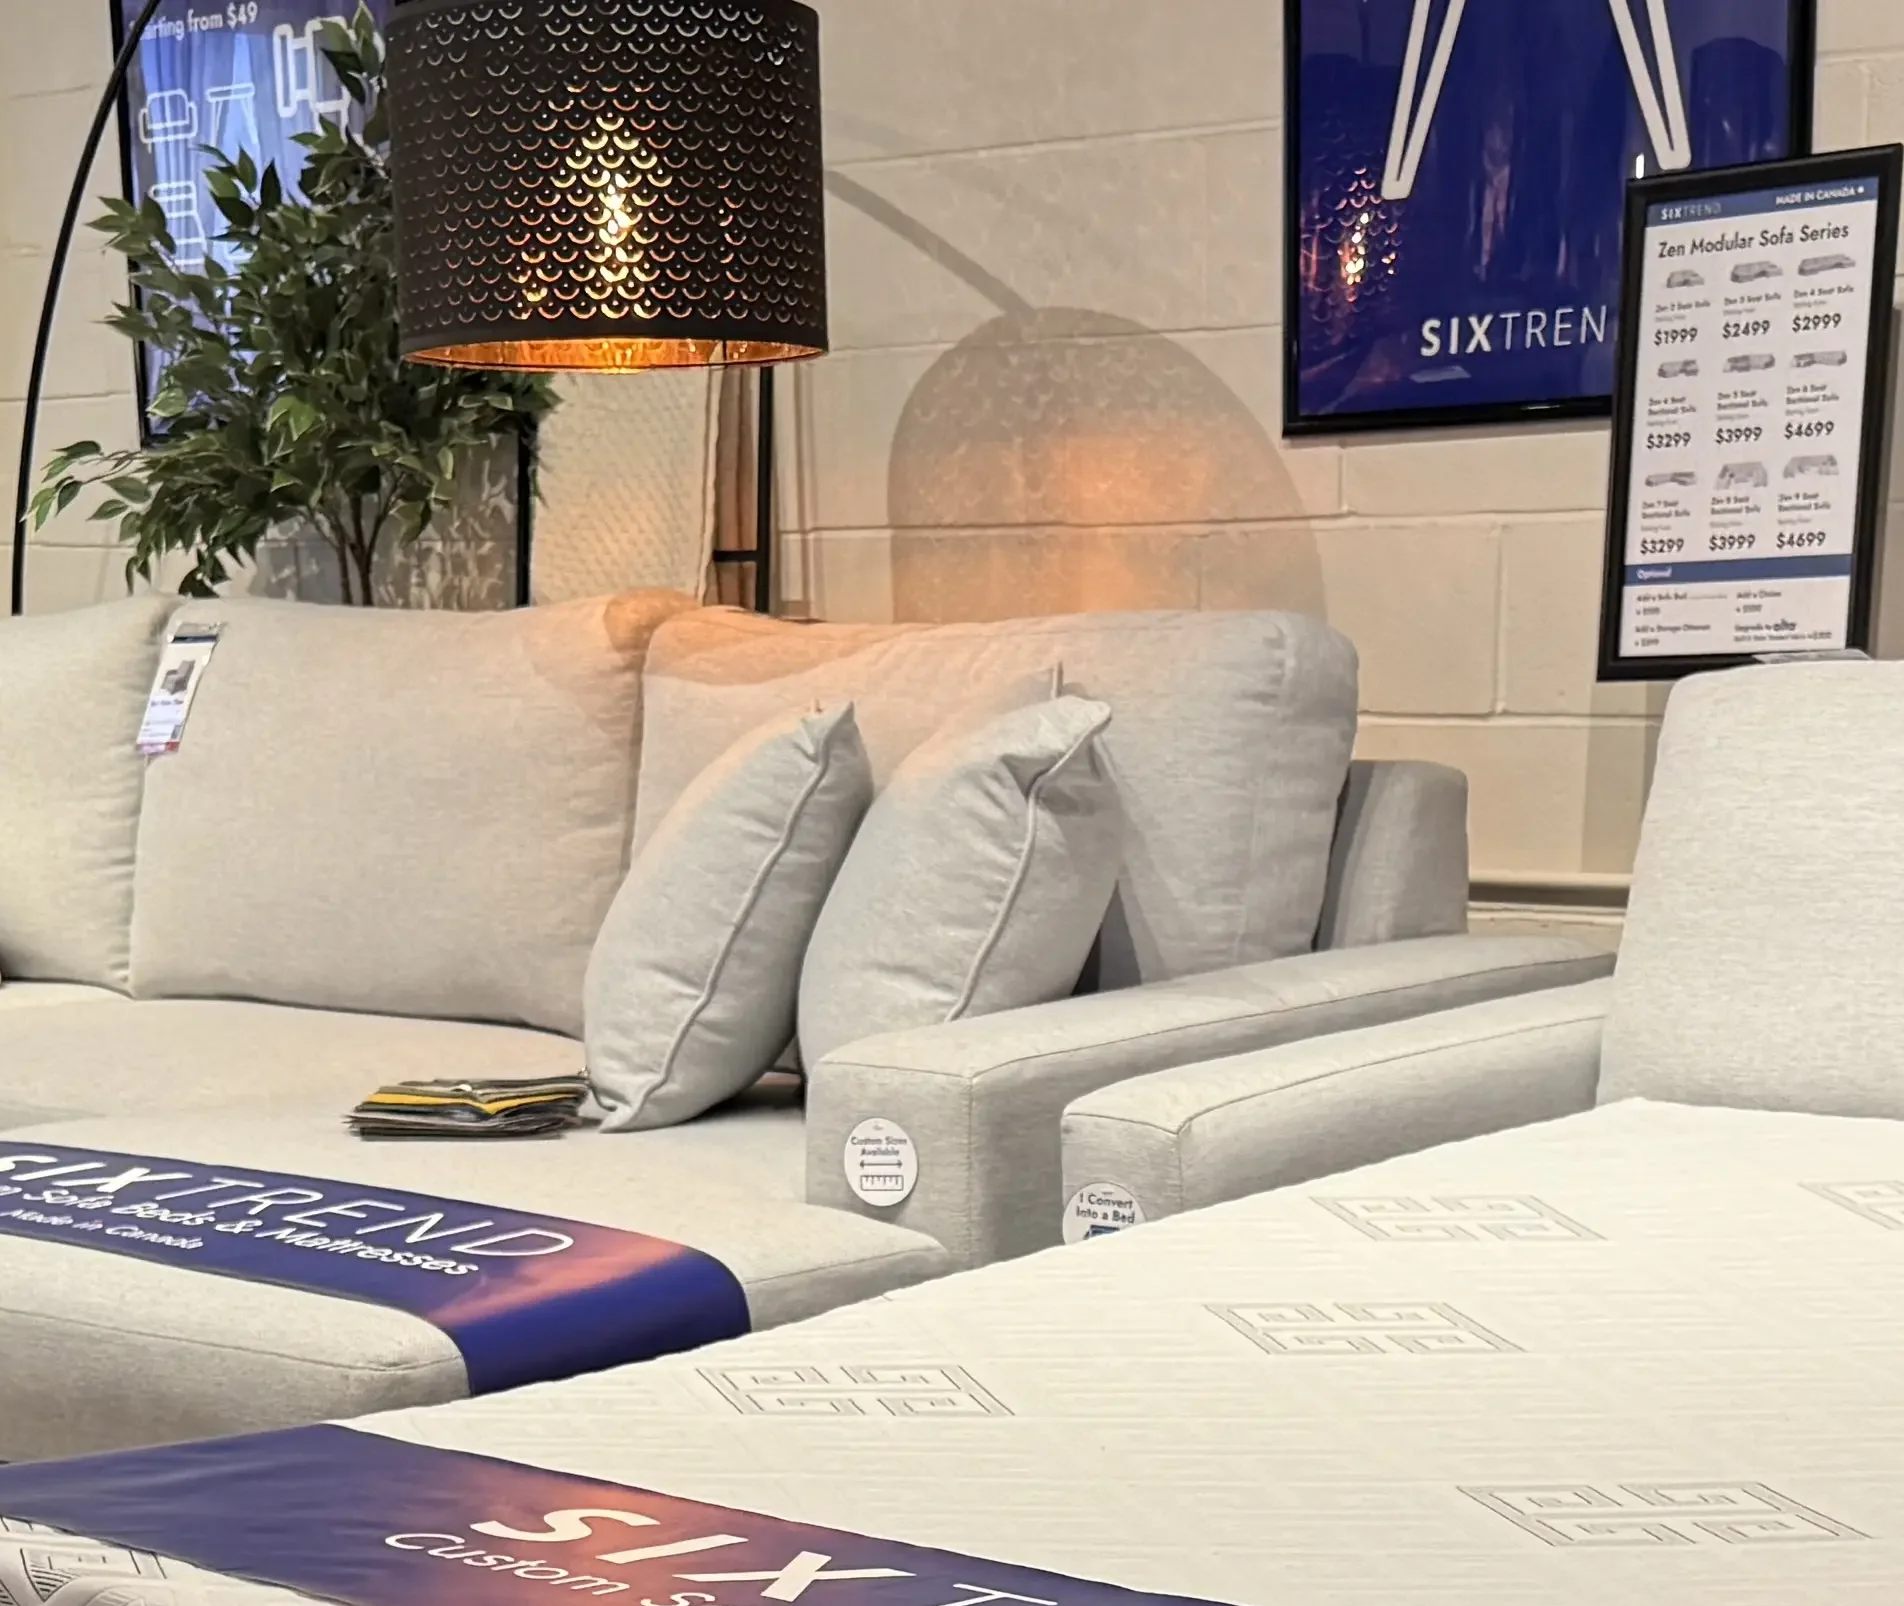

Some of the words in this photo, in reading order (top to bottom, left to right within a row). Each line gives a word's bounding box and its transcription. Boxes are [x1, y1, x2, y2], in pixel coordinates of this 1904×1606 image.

[128, 15, 184, 41] arting
[187, 8, 223, 33] from
[227, 1, 258, 30] $49
[1776, 193, 1801, 206] MADE
[1804, 190, 1815, 202] IN
[1816, 187, 1856, 201] CANADA
[1660, 202, 1722, 221] SIXTREND
[1657, 241, 1686, 259] Zen
[1690, 232, 1754, 255] Modular
[1759, 225, 1794, 248] Sofa
[1799, 222, 1850, 243] Series
[1420, 304, 1618, 357] SIXTREN
[1722, 320, 1771, 339] $2499
[1792, 313, 1842, 333] $2999
[1654, 327, 1698, 347] $1999
[1715, 426, 1763, 444] $3999
[1784, 420, 1835, 440] $4699
[1646, 432, 1691, 450] $3299
[1640, 538, 1684, 555] $3299
[1708, 534, 1756, 552] $3999
[1776, 531, 1826, 549] $4699
[1079, 1191, 1084, 1204] I
[1087, 1192, 1134, 1209] Convert
[1076, 1205, 1099, 1219] Into
[1102, 1211, 1109, 1220] a
[1112, 1209, 1136, 1224] Bed
[0, 1208, 74, 1226] Made
[72, 1219, 104, 1231] in
[105, 1224, 205, 1250] Canada
[23, 1188, 115, 1210] Sofa
[109, 1201, 216, 1227] Beds
[214, 1218, 264, 1235] &
[254, 1227, 479, 1277] Mattresses
[383, 1532, 631, 1598] Custom
